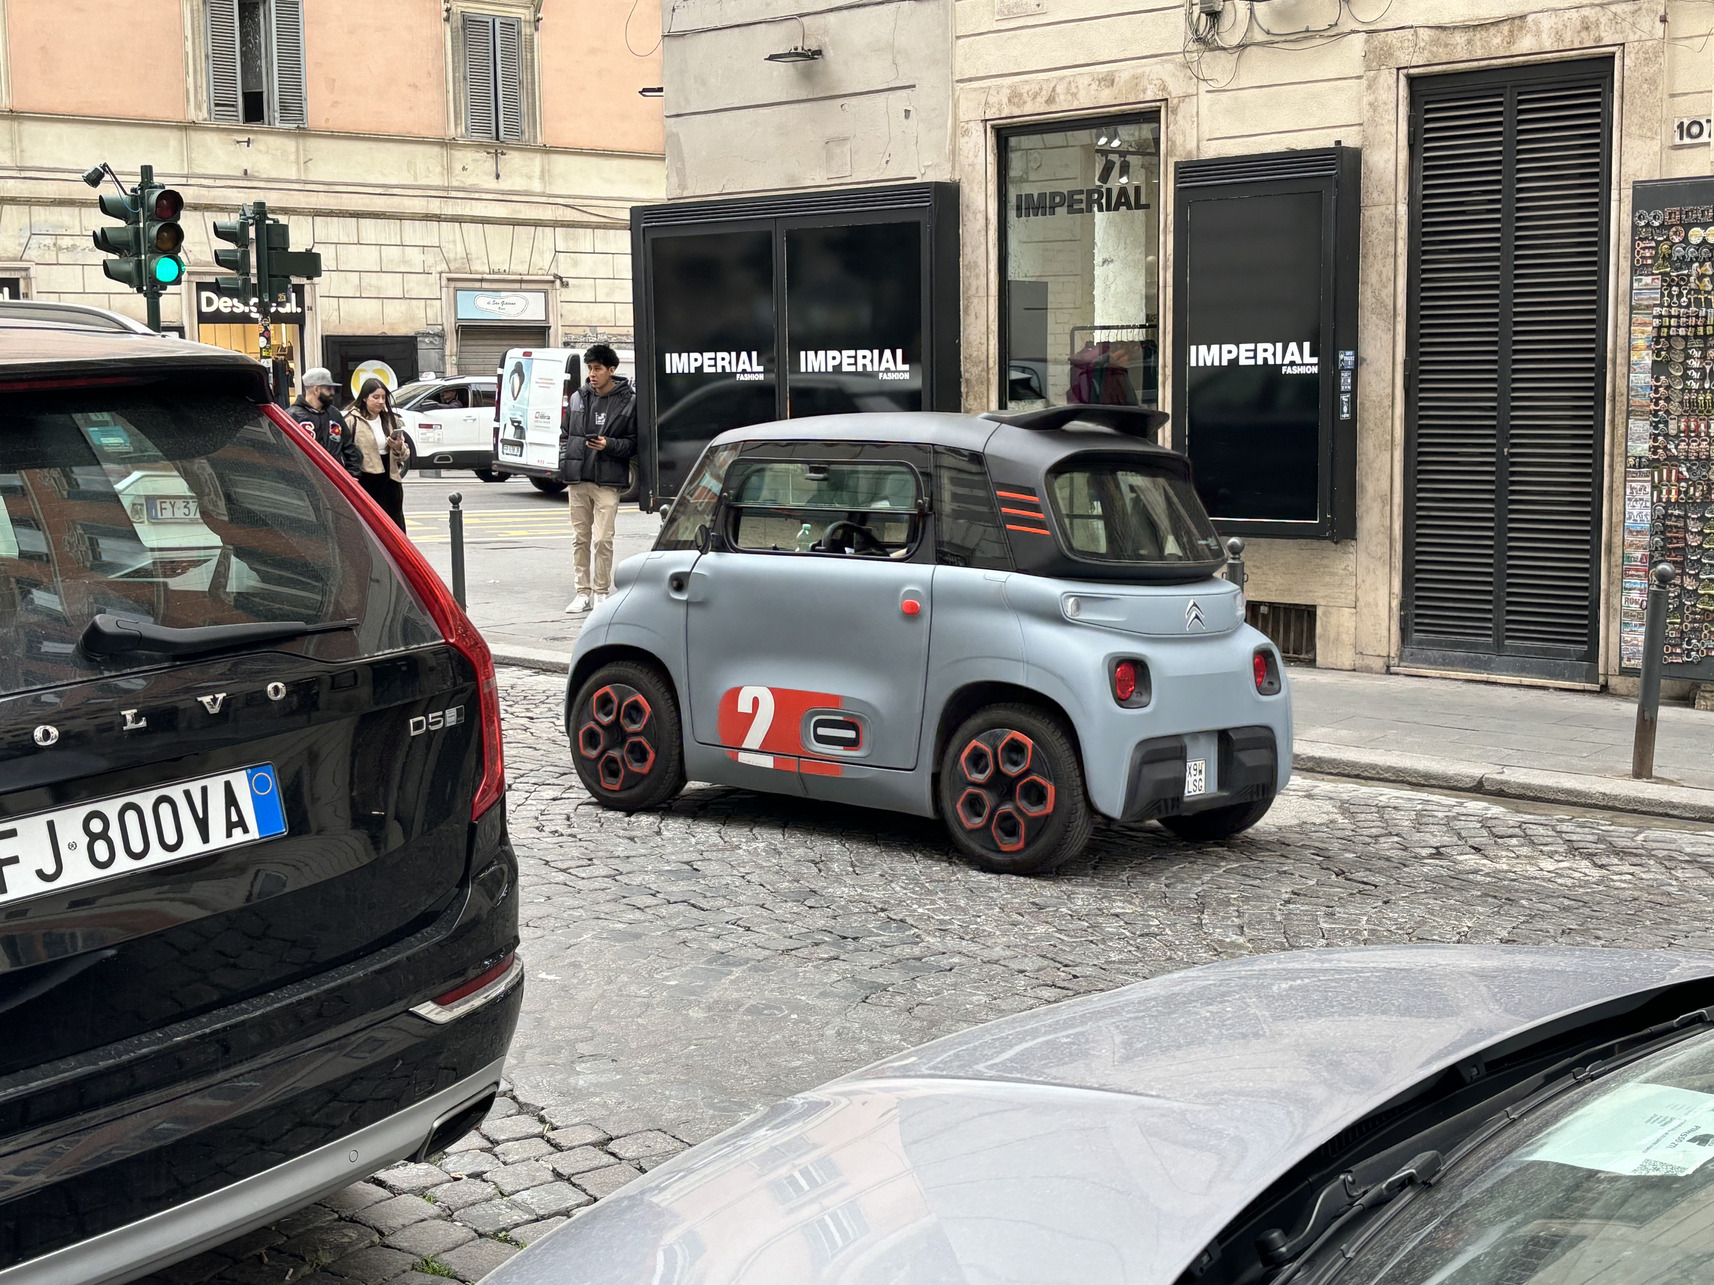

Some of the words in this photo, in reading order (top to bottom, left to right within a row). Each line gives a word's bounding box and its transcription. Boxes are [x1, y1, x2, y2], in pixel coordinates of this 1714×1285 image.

[1016, 186, 1150, 218] IMPERIAL
[201, 291, 302, 319] Desgal.
[665, 351, 764, 374] IMPERIAL
[800, 349, 909, 373] IMPERIAL
[1190, 341, 1318, 366] IMPERIAL
[736, 373, 764, 381] FASHION
[879, 372, 909, 380] FASHION
[1281, 365, 1318, 375] FASHION
[160, 501, 176, 517] FY
[1624, 596, 1642, 606] ROM
[409, 711, 443, 737] D5
[737, 685, 775, 769] 2
[1187, 761, 1204, 778] X9W
[1187, 778, 1203, 794] LSG
